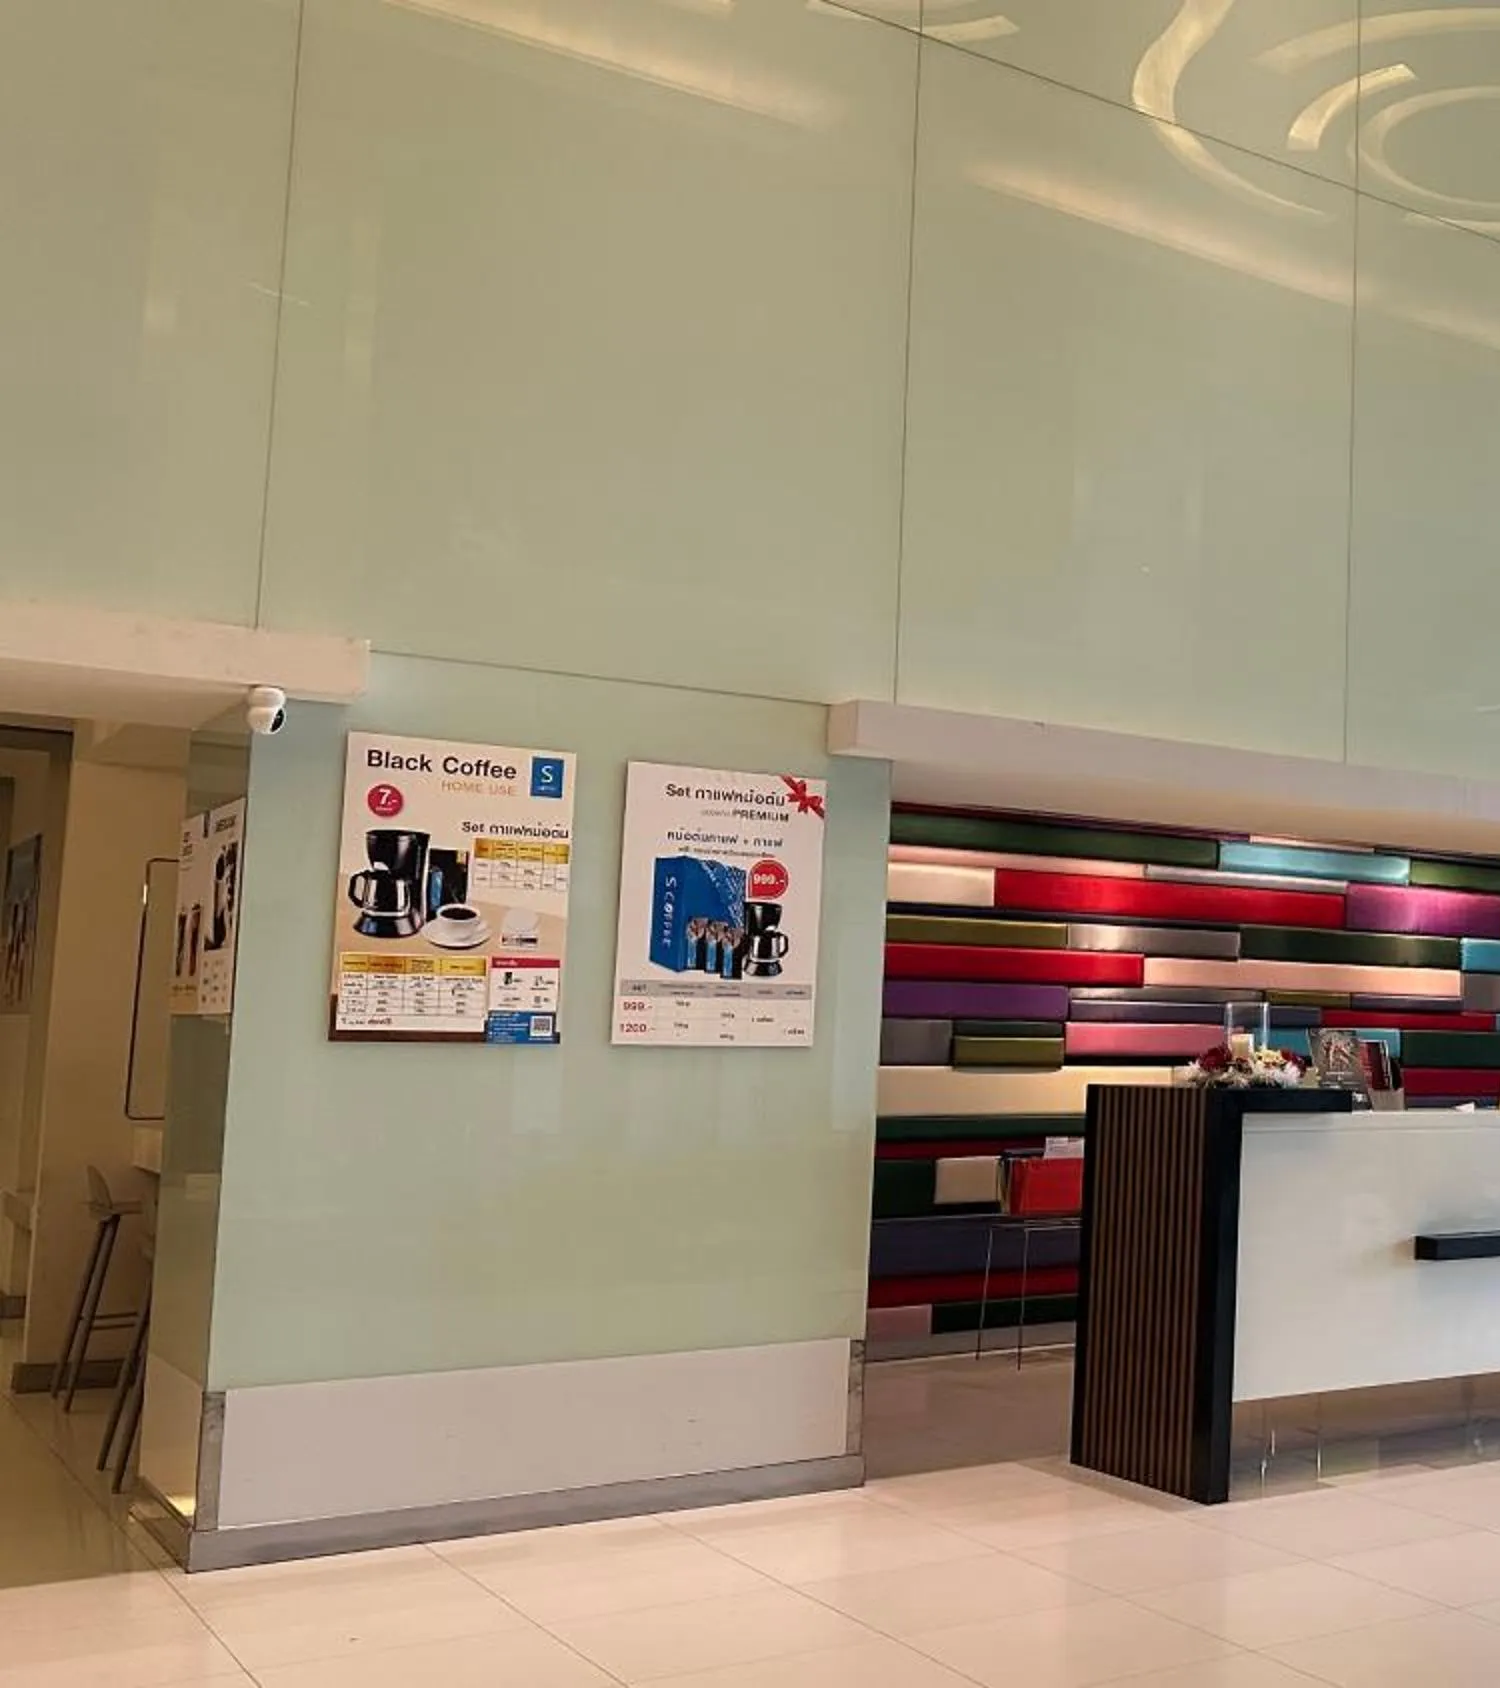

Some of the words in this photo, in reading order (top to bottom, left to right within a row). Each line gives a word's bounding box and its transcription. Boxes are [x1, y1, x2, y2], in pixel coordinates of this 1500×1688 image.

[367, 750, 432, 773] Black
[442, 757, 517, 779] Coffee
[541, 766, 554, 783] S
[441, 780, 482, 794] HOME
[489, 785, 517, 797] USE
[666, 784, 691, 799] Set
[732, 810, 789, 822] PREMIUM
[461, 822, 485, 833] Set
